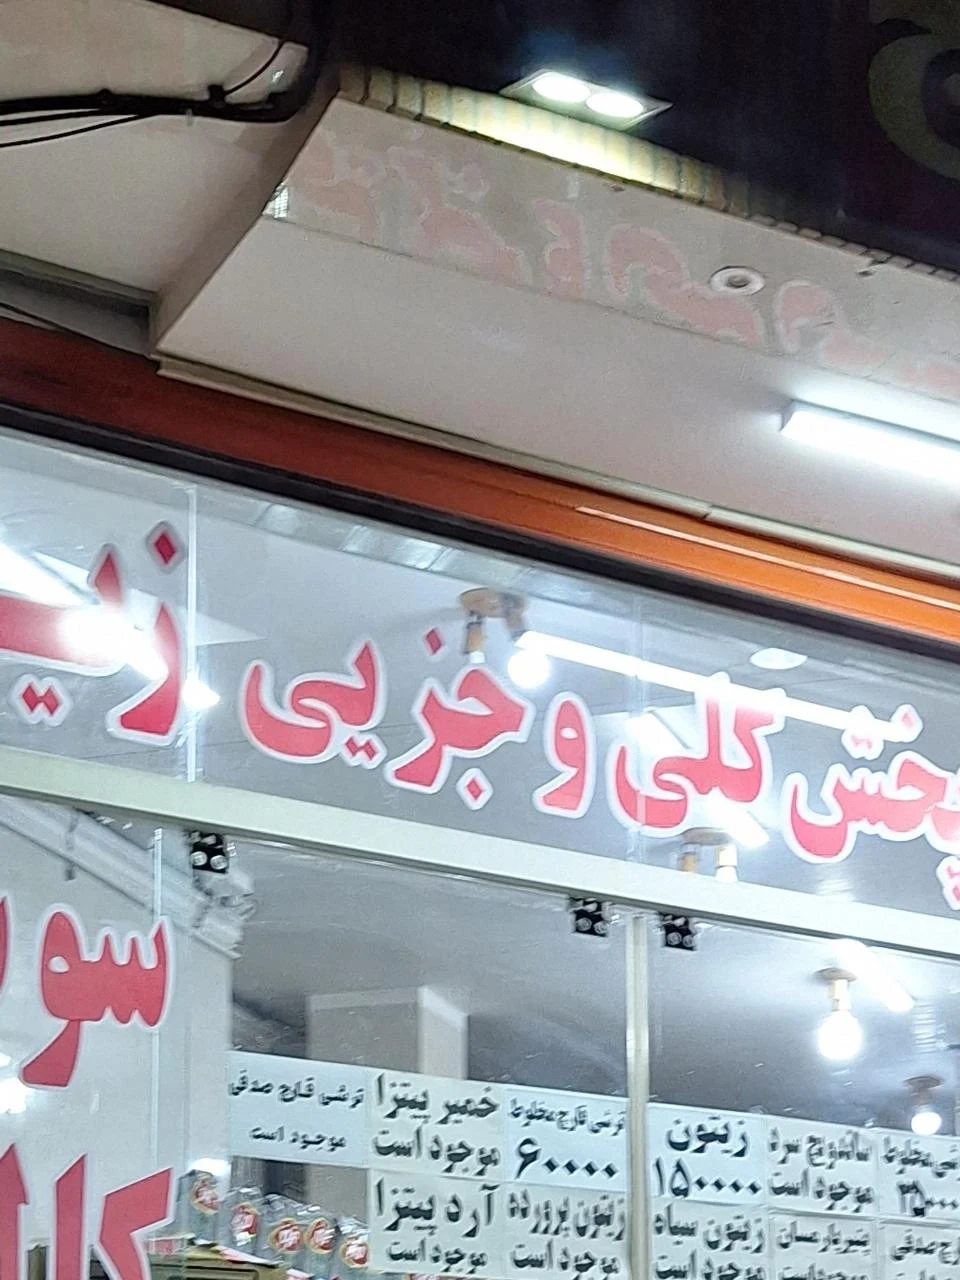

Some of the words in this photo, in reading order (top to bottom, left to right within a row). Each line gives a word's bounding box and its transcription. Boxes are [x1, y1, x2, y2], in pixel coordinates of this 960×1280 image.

[536, 696, 594, 817] و
[610, 675, 784, 836] کلی
[376, 1073, 430, 1122] پیتزا
[436, 1086, 500, 1124] خمیر
[249, 1126, 285, 1142] است
[290, 1131, 346, 1151] موجود
[374, 1125, 423, 1159] است
[667, 1116, 748, 1158] زیتون
[430, 1135, 501, 1176] موجود
[515, 1137, 618, 1180] ۶۰۰۰۰
[653, 1156, 761, 1198] ۱۵۰۰۰۰
[770, 1168, 810, 1196] است
[815, 1176, 874, 1212] موجود
[376, 1177, 436, 1236] پیتزا
[445, 1184, 500, 1238] آرد
[508, 1189, 571, 1238] پرورده
[574, 1195, 625, 1241] زیتون
[654, 1203, 698, 1246] سیاه
[387, 1237, 427, 1261] است
[512, 1239, 553, 1269] است
[704, 1215, 765, 1253] زیتون
[431, 1244, 487, 1274] موجود
[655, 1249, 697, 1280] است
